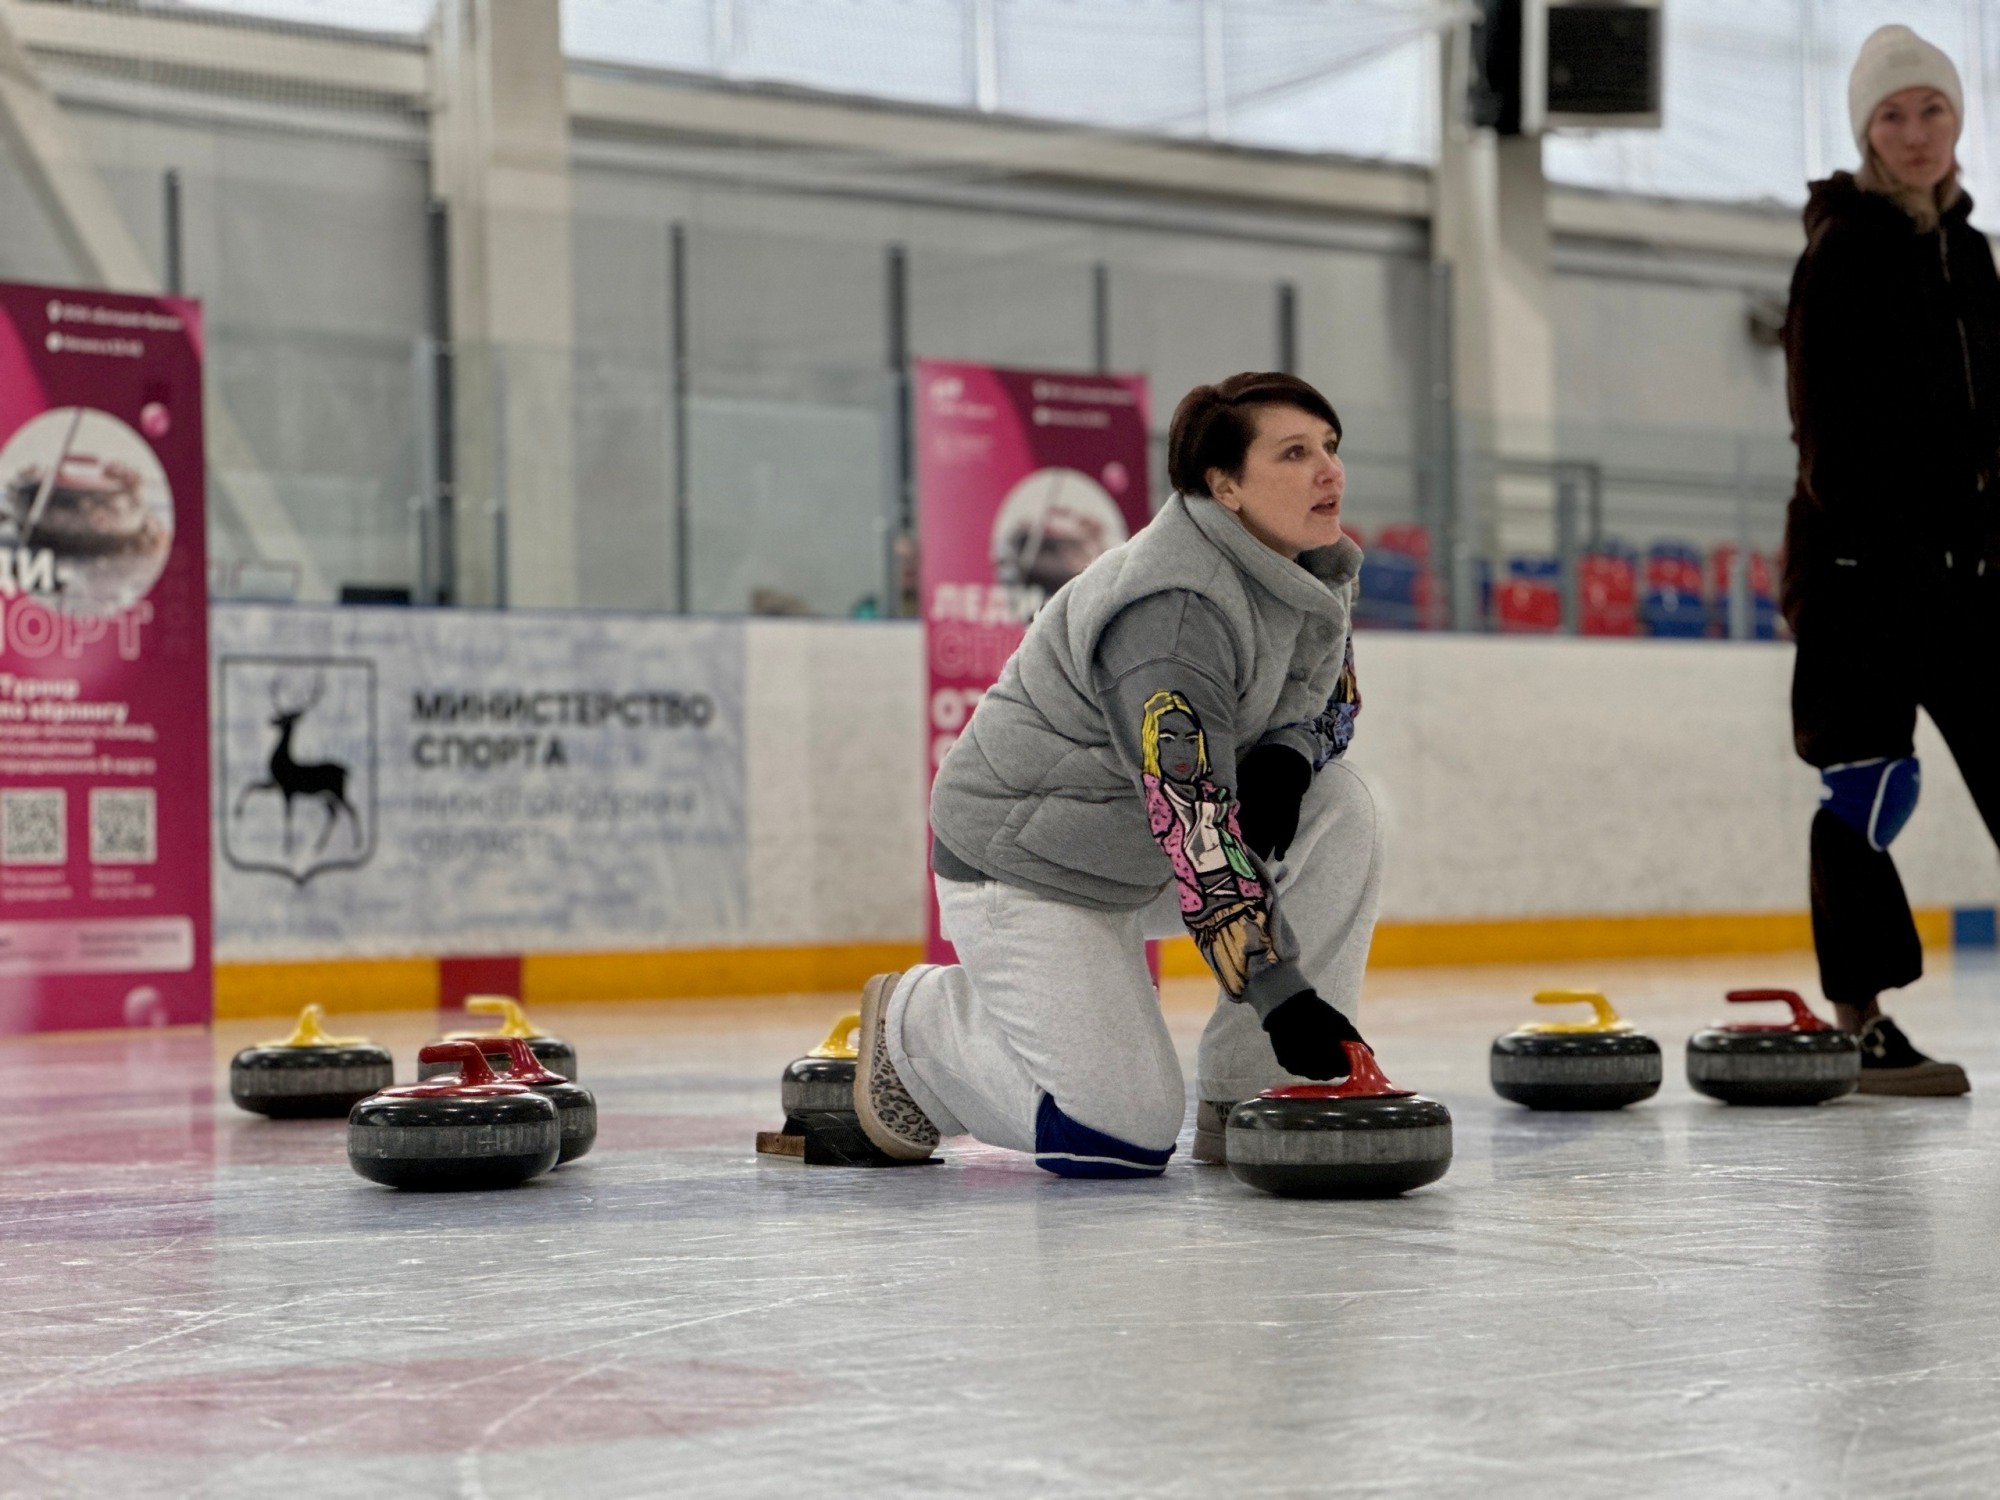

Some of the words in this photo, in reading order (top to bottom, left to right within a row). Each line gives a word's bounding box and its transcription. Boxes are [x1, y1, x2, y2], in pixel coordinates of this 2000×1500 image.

[0, 598, 154, 660] ОРТ
[411, 690, 714, 727] МИНИСТЕРСТВО
[411, 734, 568, 769] СПОРТА
